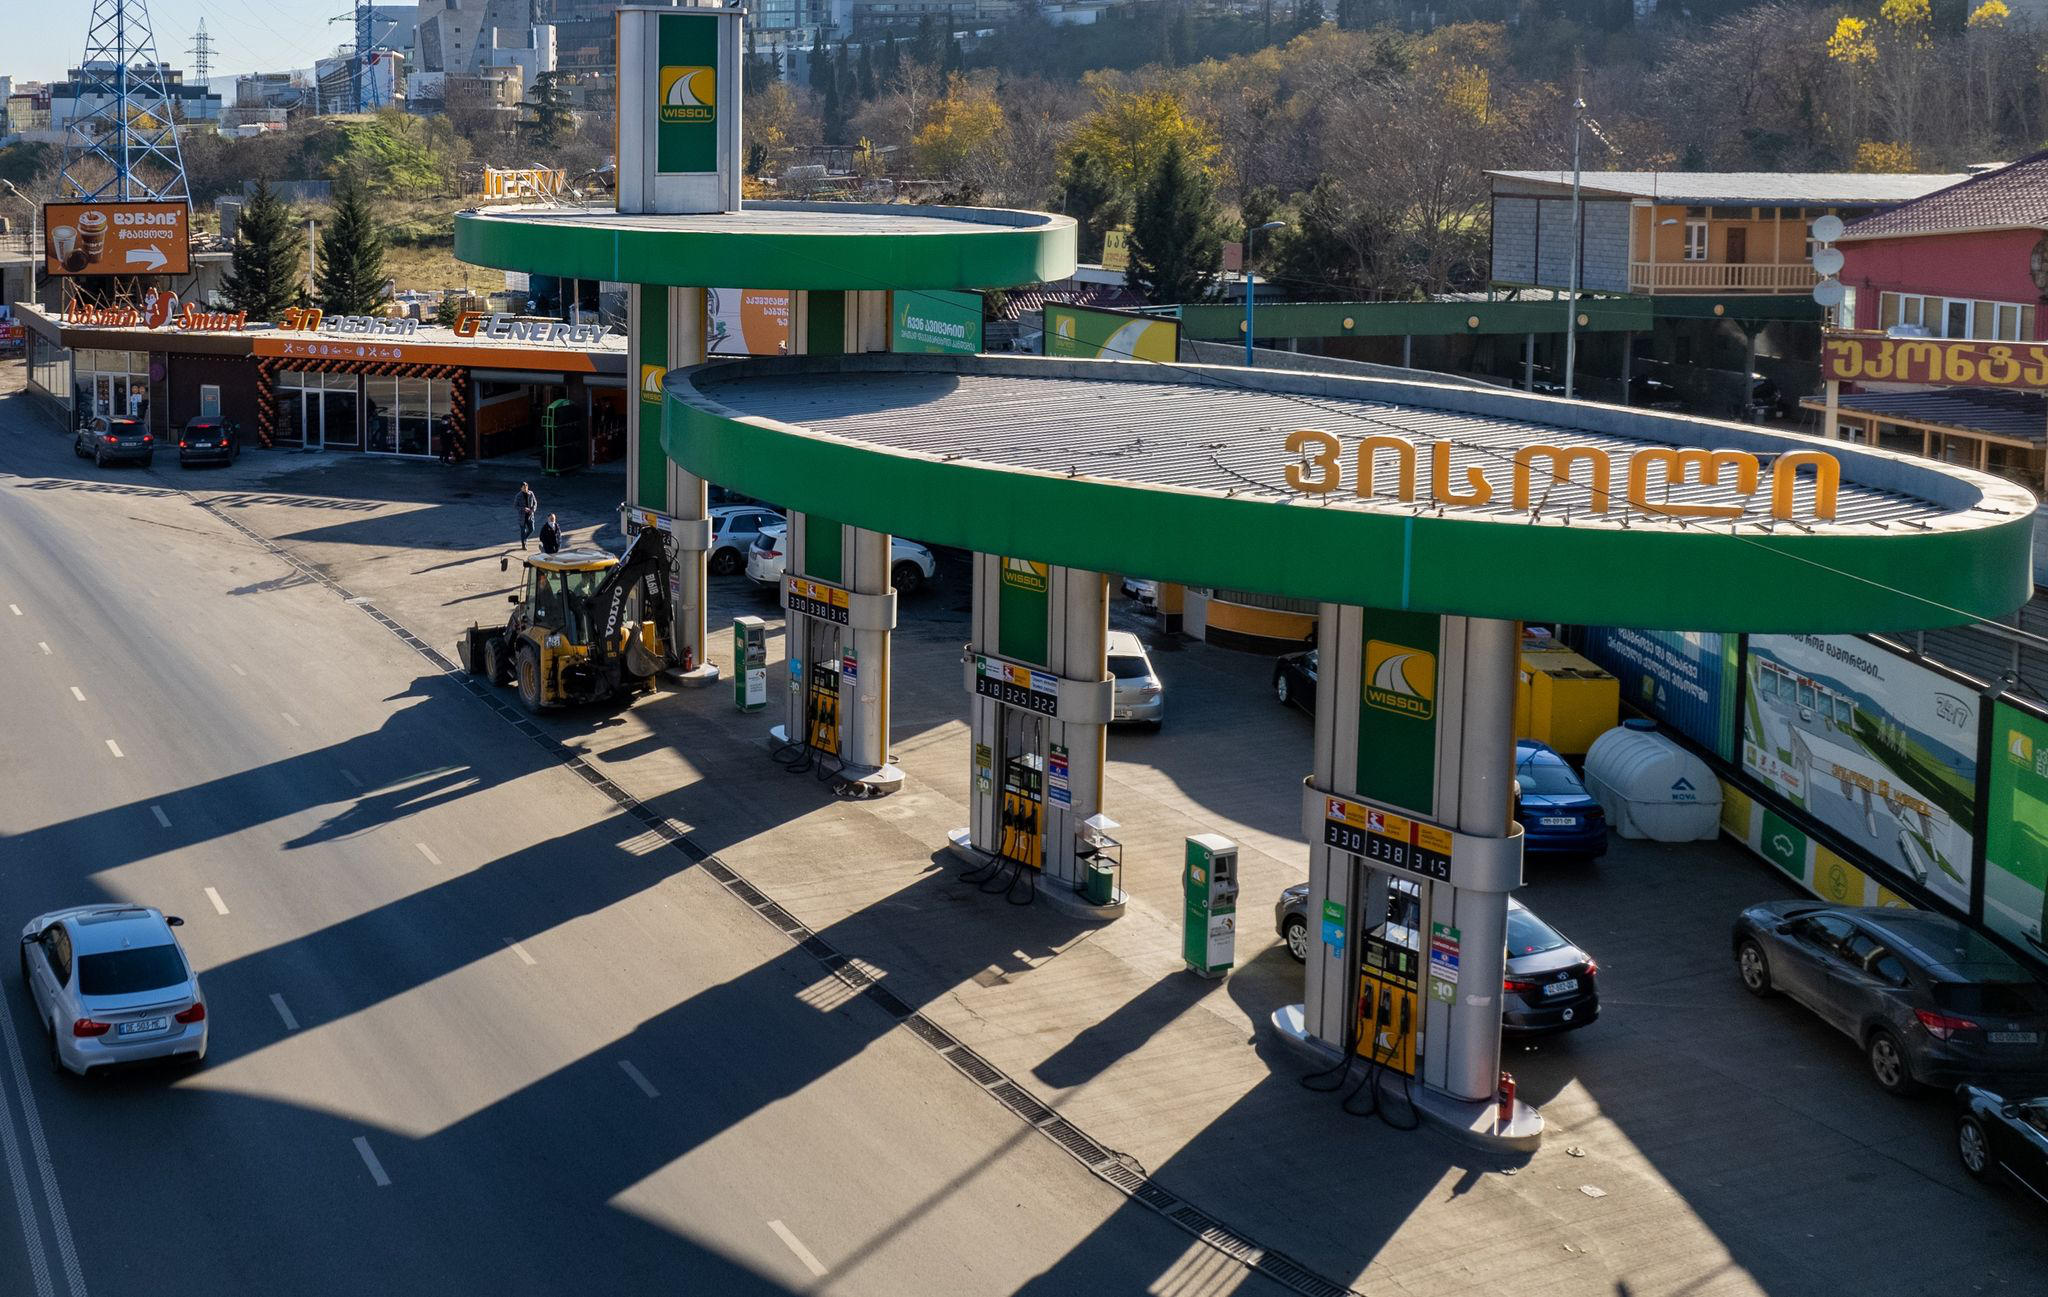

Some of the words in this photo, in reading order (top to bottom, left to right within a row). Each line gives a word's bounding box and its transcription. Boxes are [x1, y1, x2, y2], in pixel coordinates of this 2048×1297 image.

[663, 108, 712, 118] WISSOL
[177, 302, 247, 331] Smart
[1284, 429, 1840, 520] ვისოლი
[1006, 572, 1045, 588] WISSOL
[604, 586, 623, 638] VOLVO
[790, 597, 806, 610] 330
[810, 603, 826, 617] 338
[831, 609, 847, 623] 315
[980, 680, 1000, 696] 318
[1006, 688, 1027, 705] 325
[1034, 696, 1055, 713] 322
[1369, 690, 1429, 714] WISSOL
[1672, 793, 1697, 801] NOVA
[1330, 827, 1360, 850] 330
[1372, 840, 1403, 863] 338
[1414, 853, 1447, 877] 315
